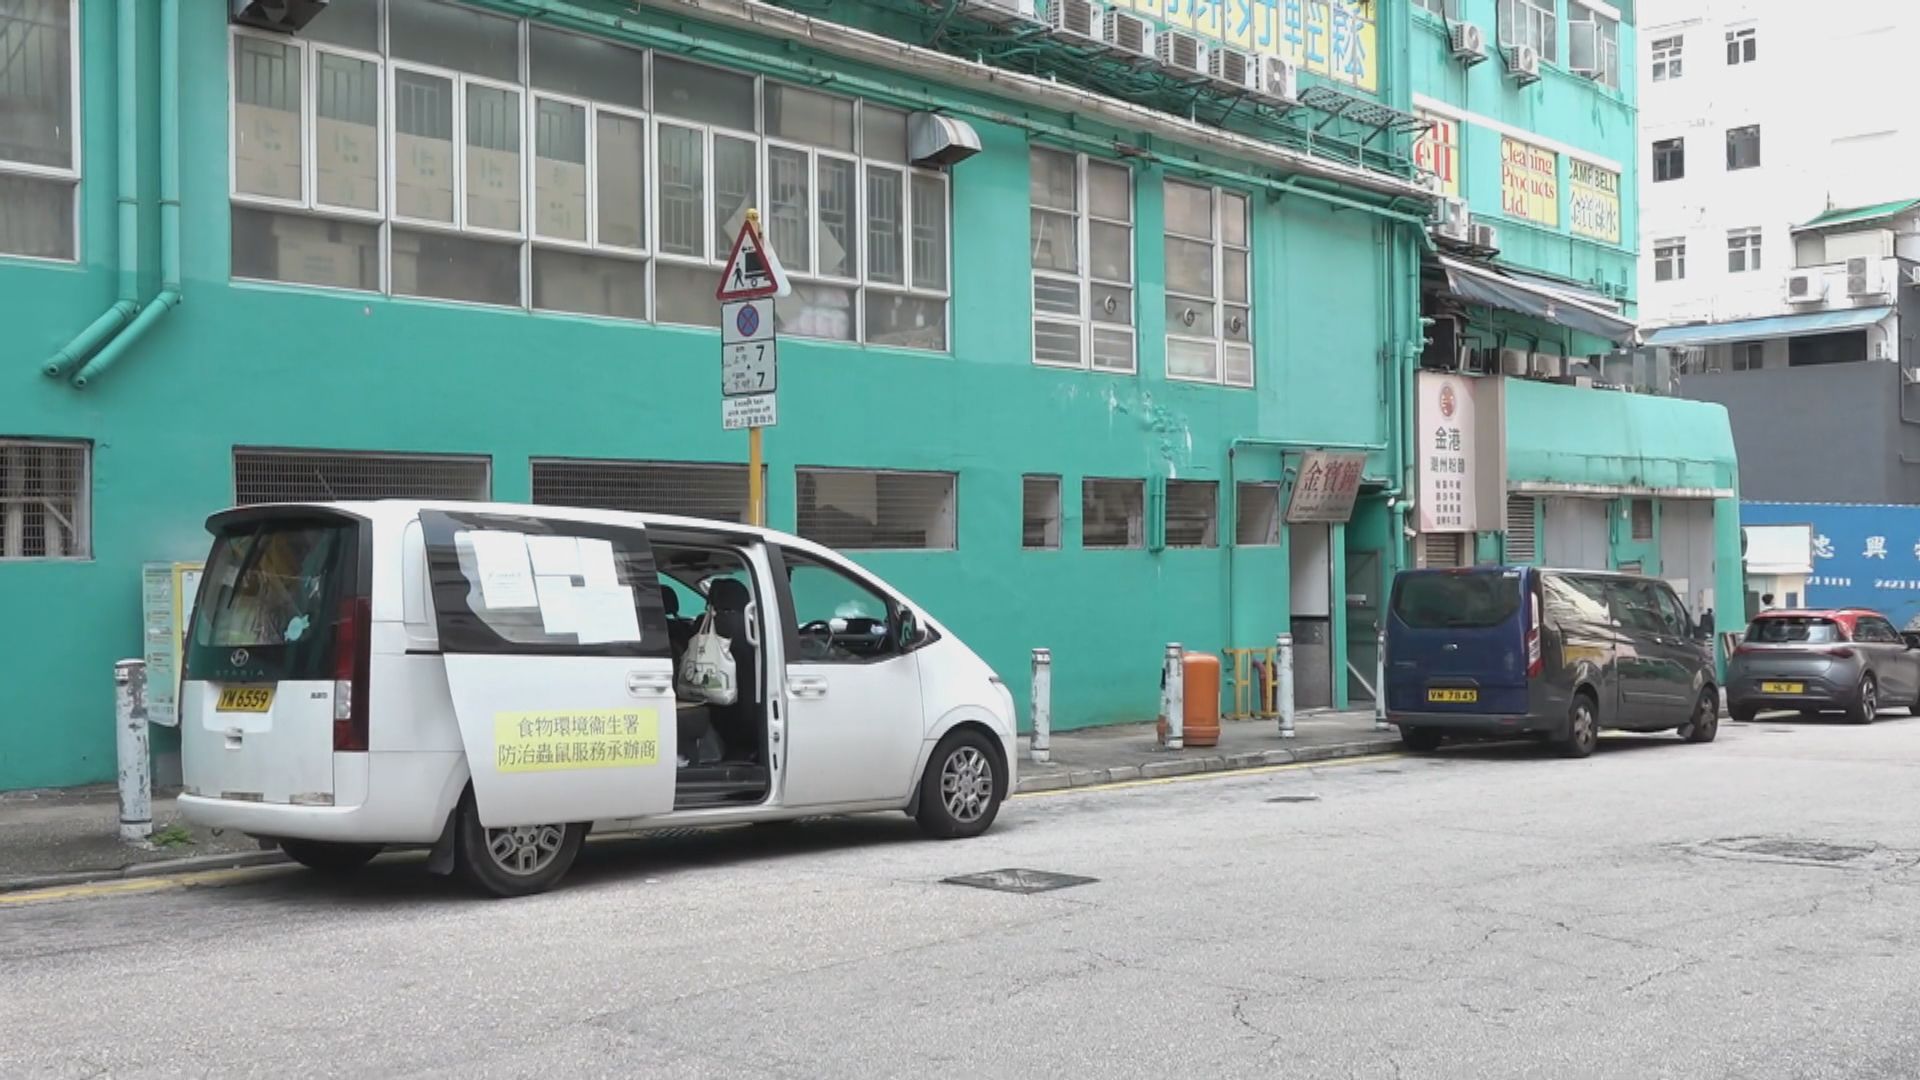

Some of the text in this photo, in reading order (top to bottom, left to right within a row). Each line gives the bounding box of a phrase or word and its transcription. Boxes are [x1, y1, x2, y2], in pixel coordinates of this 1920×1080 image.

[755, 344, 765, 361] 7
[756, 371, 766, 388] 7
[1435, 426, 1461, 451] 金港
[236, 689, 269, 708] 6559
[498, 740, 657, 767] 防治蟲鼠服務承辦商
